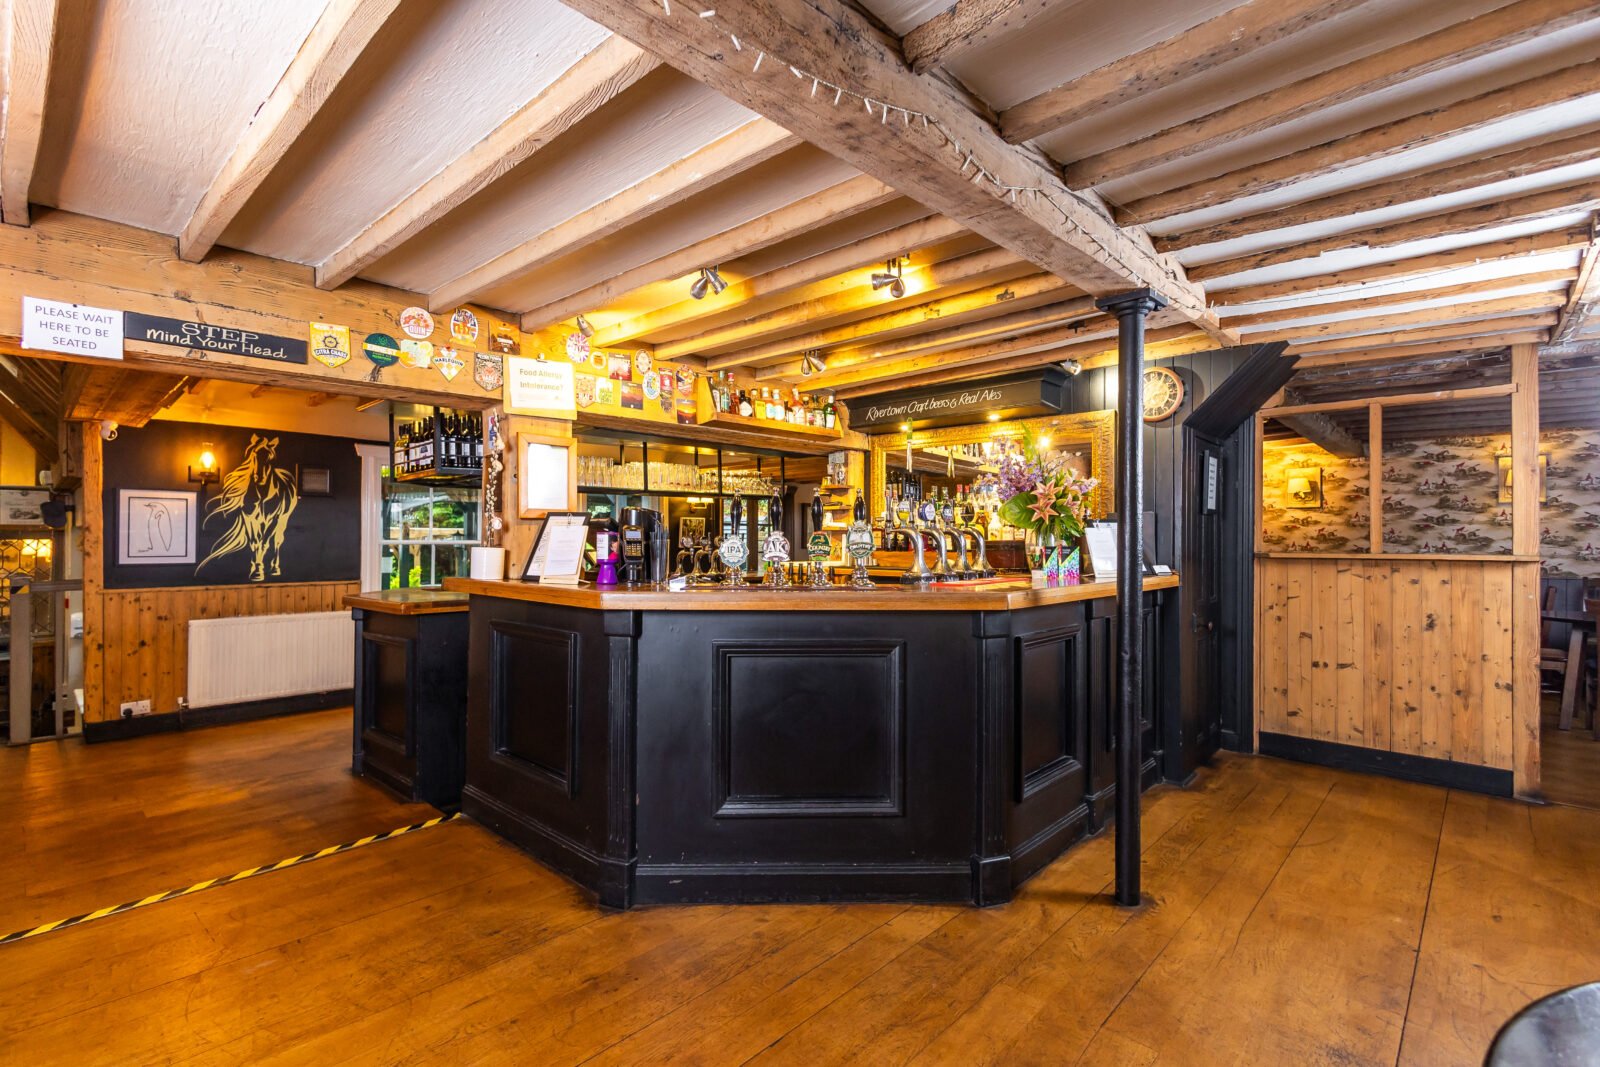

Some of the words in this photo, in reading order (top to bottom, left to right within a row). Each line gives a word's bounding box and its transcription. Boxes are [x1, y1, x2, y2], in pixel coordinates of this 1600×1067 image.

[35, 305, 79, 321] PLEASE
[82, 312, 114, 325] WAIT
[39, 320, 71, 334] HERE
[75, 325, 92, 336] TO
[95, 327, 109, 338] BE
[181, 322, 259, 343] STEP
[52, 336, 97, 350] SEATED
[197, 336, 236, 351] Your
[242, 340, 287, 359] Head
[434, 357, 464, 367] HARLEQUIN
[519, 368, 537, 376] Food
[866, 405, 907, 421] Rivertown
[959, 391, 979, 406] Real
[981, 389, 1002, 401] Ales
[767, 541, 787, 553] AK
